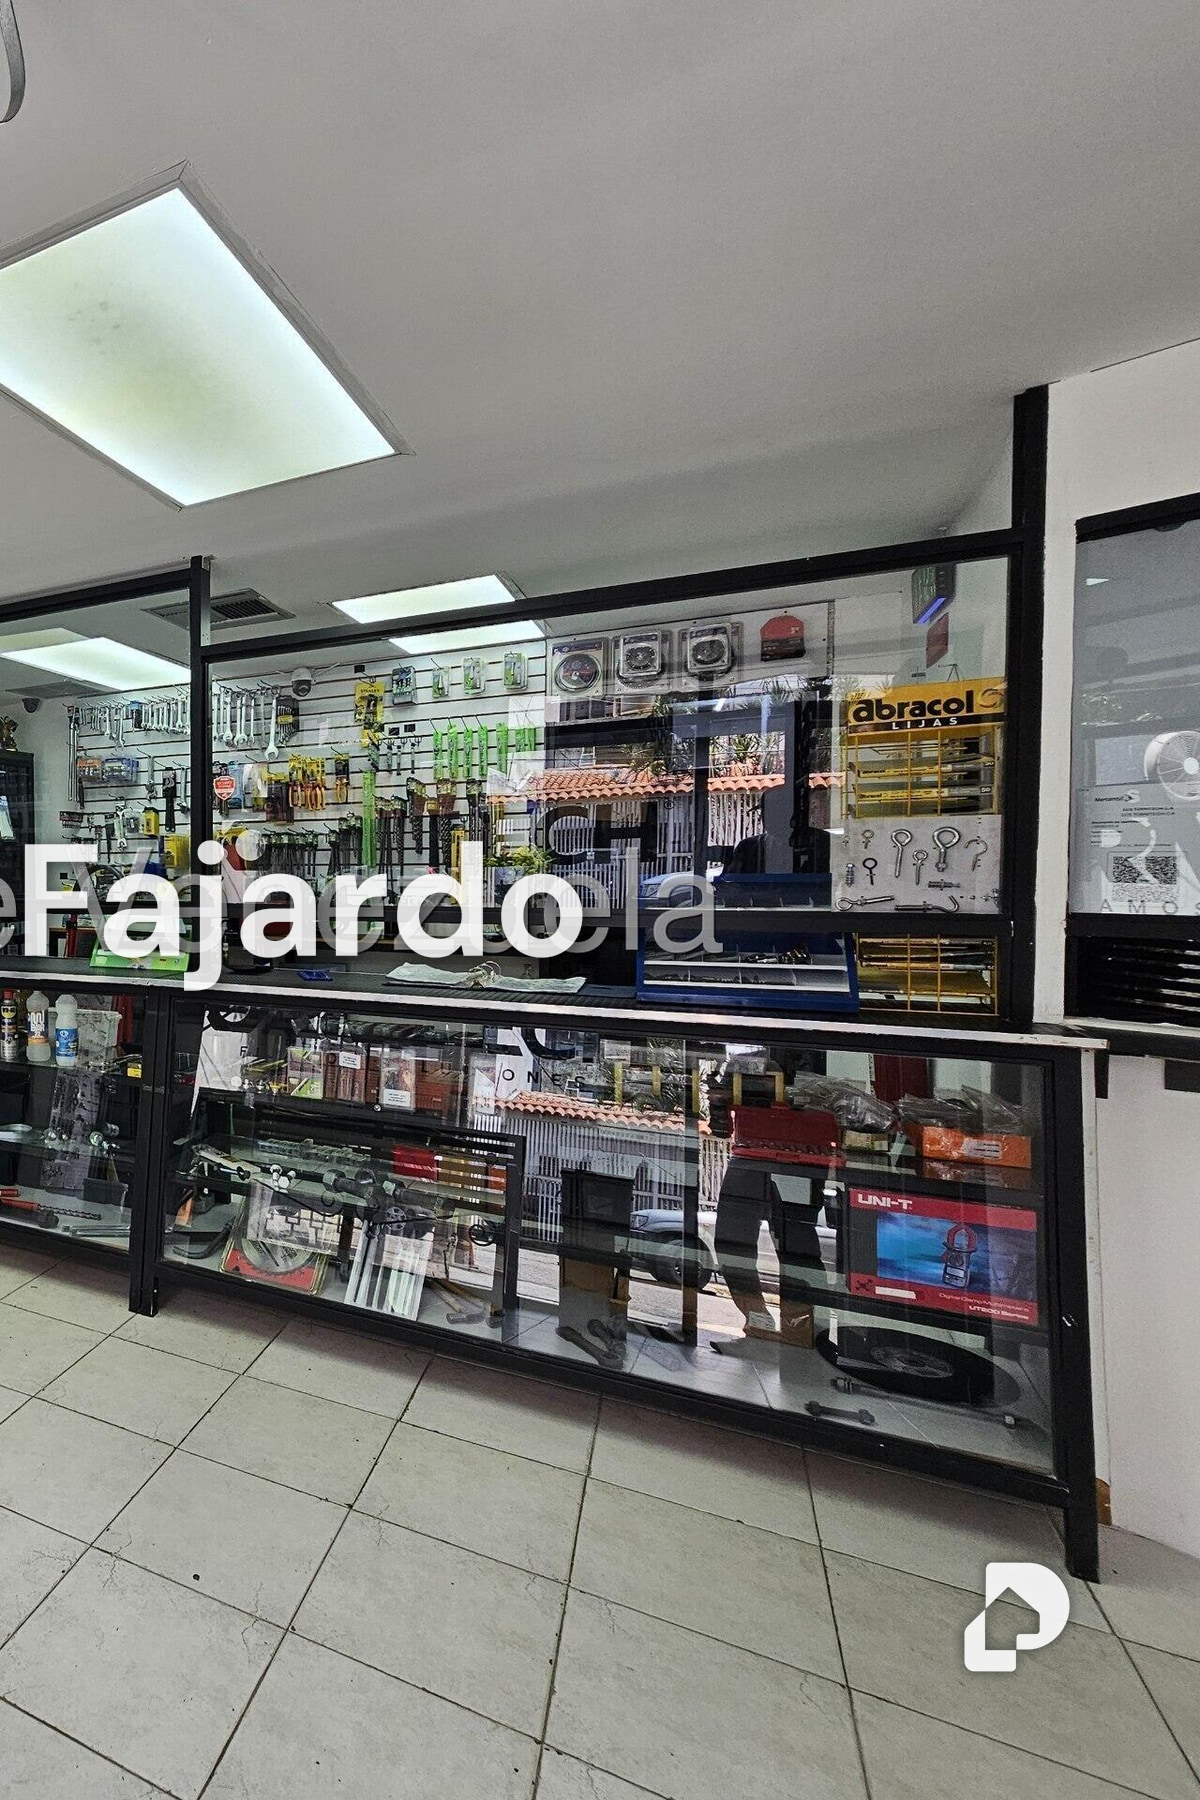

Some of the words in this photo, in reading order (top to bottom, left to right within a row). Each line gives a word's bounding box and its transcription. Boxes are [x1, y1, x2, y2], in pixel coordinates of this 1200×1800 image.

[852, 690, 974, 723] abracol
[892, 717, 958, 730] LIJAS
[857, 1193, 913, 1210] UNI-T
